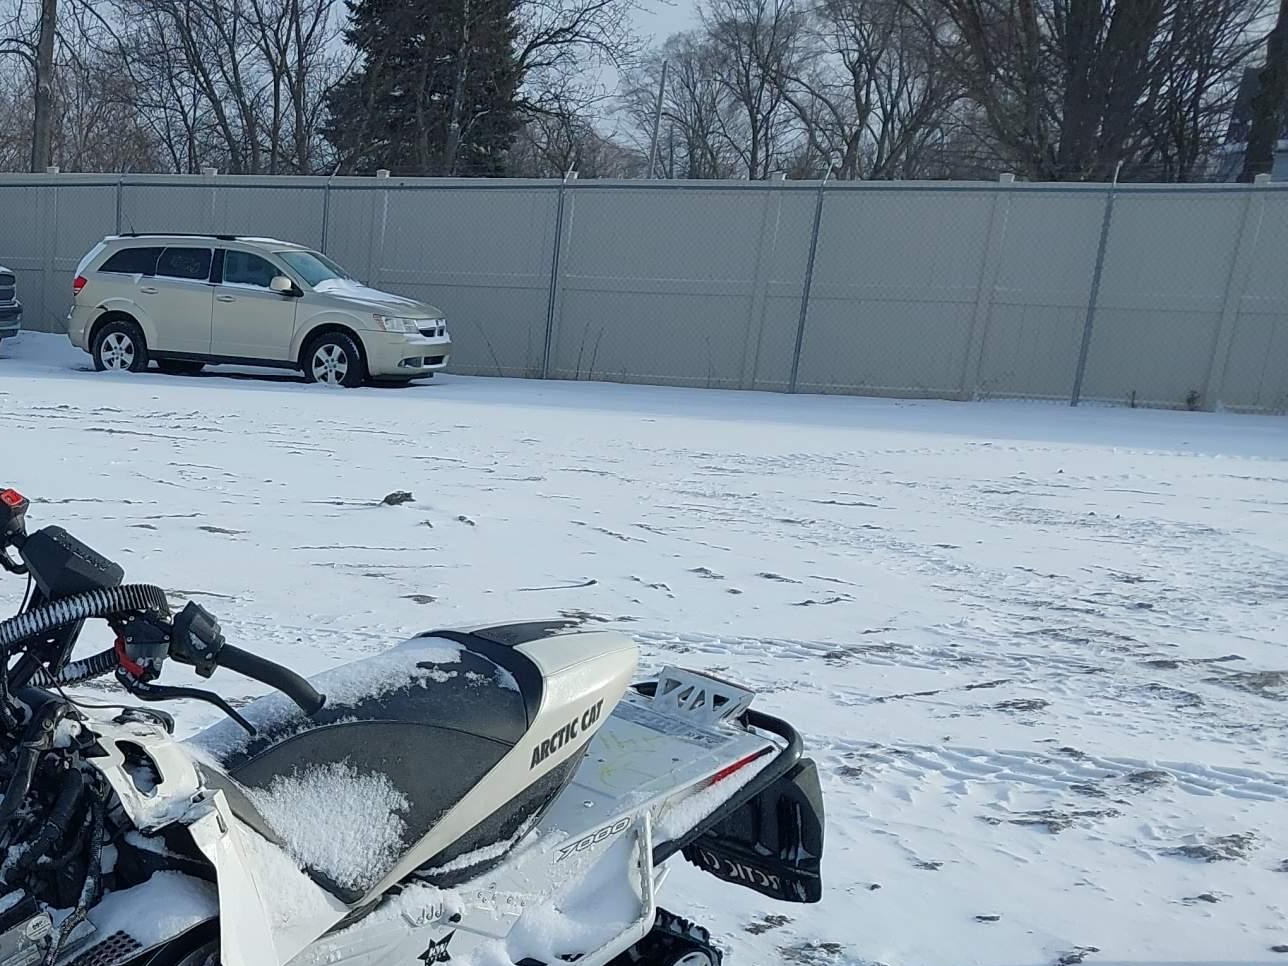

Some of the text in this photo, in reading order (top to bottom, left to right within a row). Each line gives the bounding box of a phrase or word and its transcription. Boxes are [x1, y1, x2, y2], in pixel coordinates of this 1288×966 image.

[530, 717, 579, 771] ARCTIC
[581, 697, 605, 731] CAT
[556, 817, 631, 862] 7000
